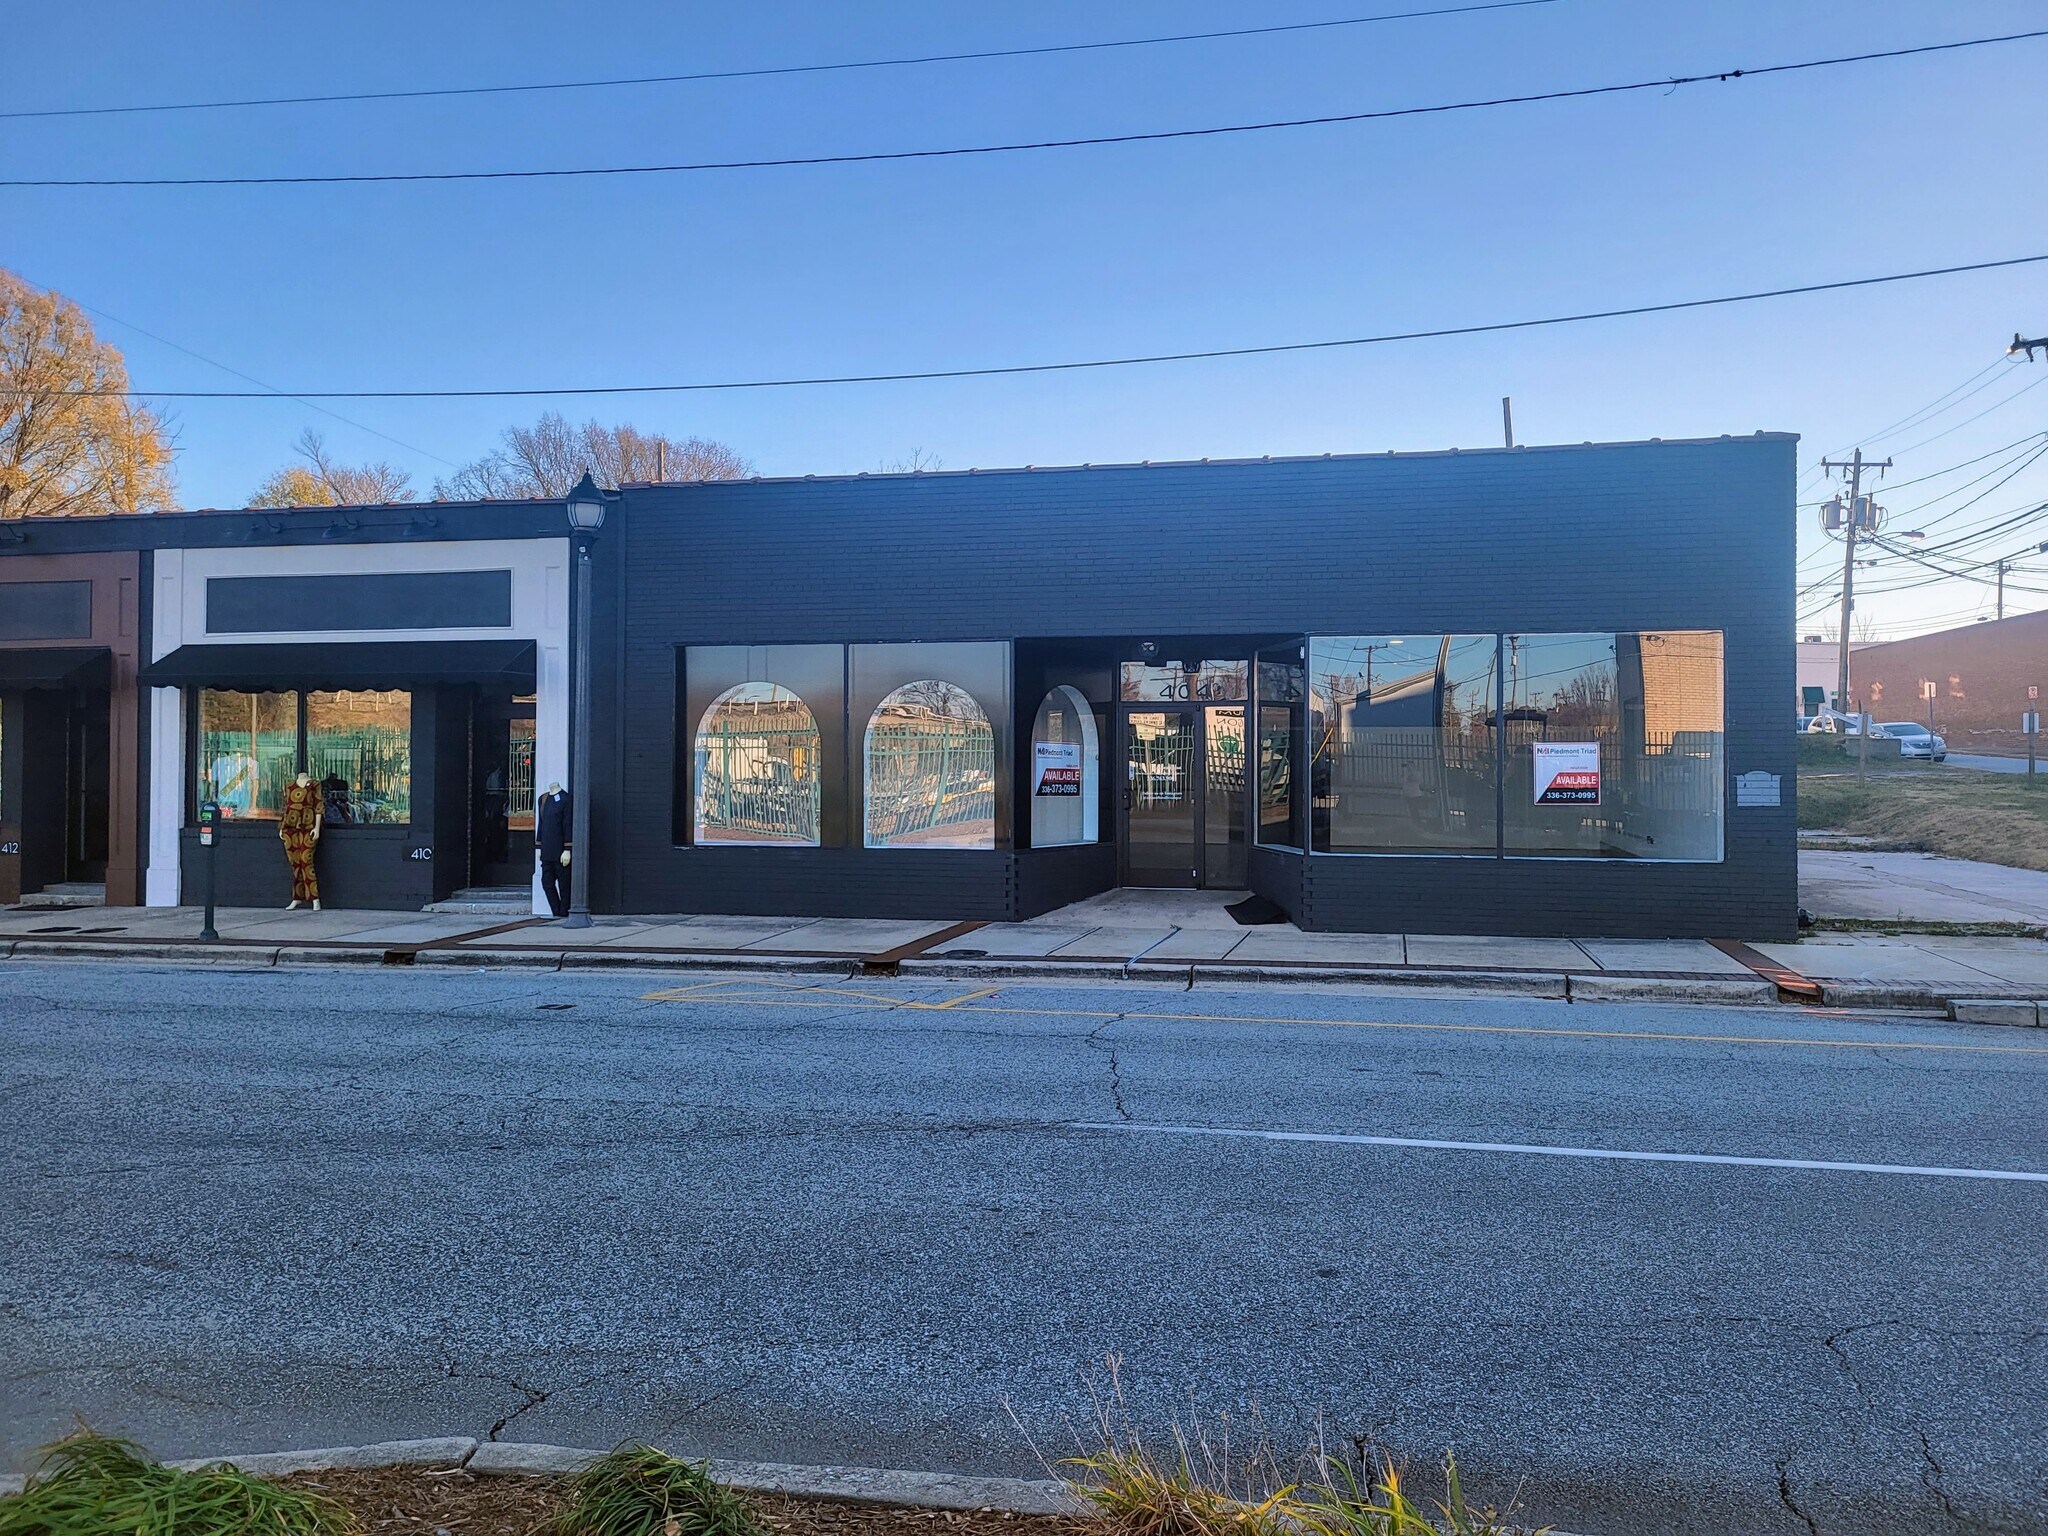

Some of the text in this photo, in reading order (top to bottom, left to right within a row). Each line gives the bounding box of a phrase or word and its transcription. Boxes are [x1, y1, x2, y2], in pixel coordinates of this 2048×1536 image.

[1044, 771, 1080, 780] AVAILABLE
[1556, 776, 1597, 784] AVAILABLE
[1041, 784, 1077, 793] 336-373-0995
[1, 842, 19, 854] 412
[410, 848, 432, 860] 410
